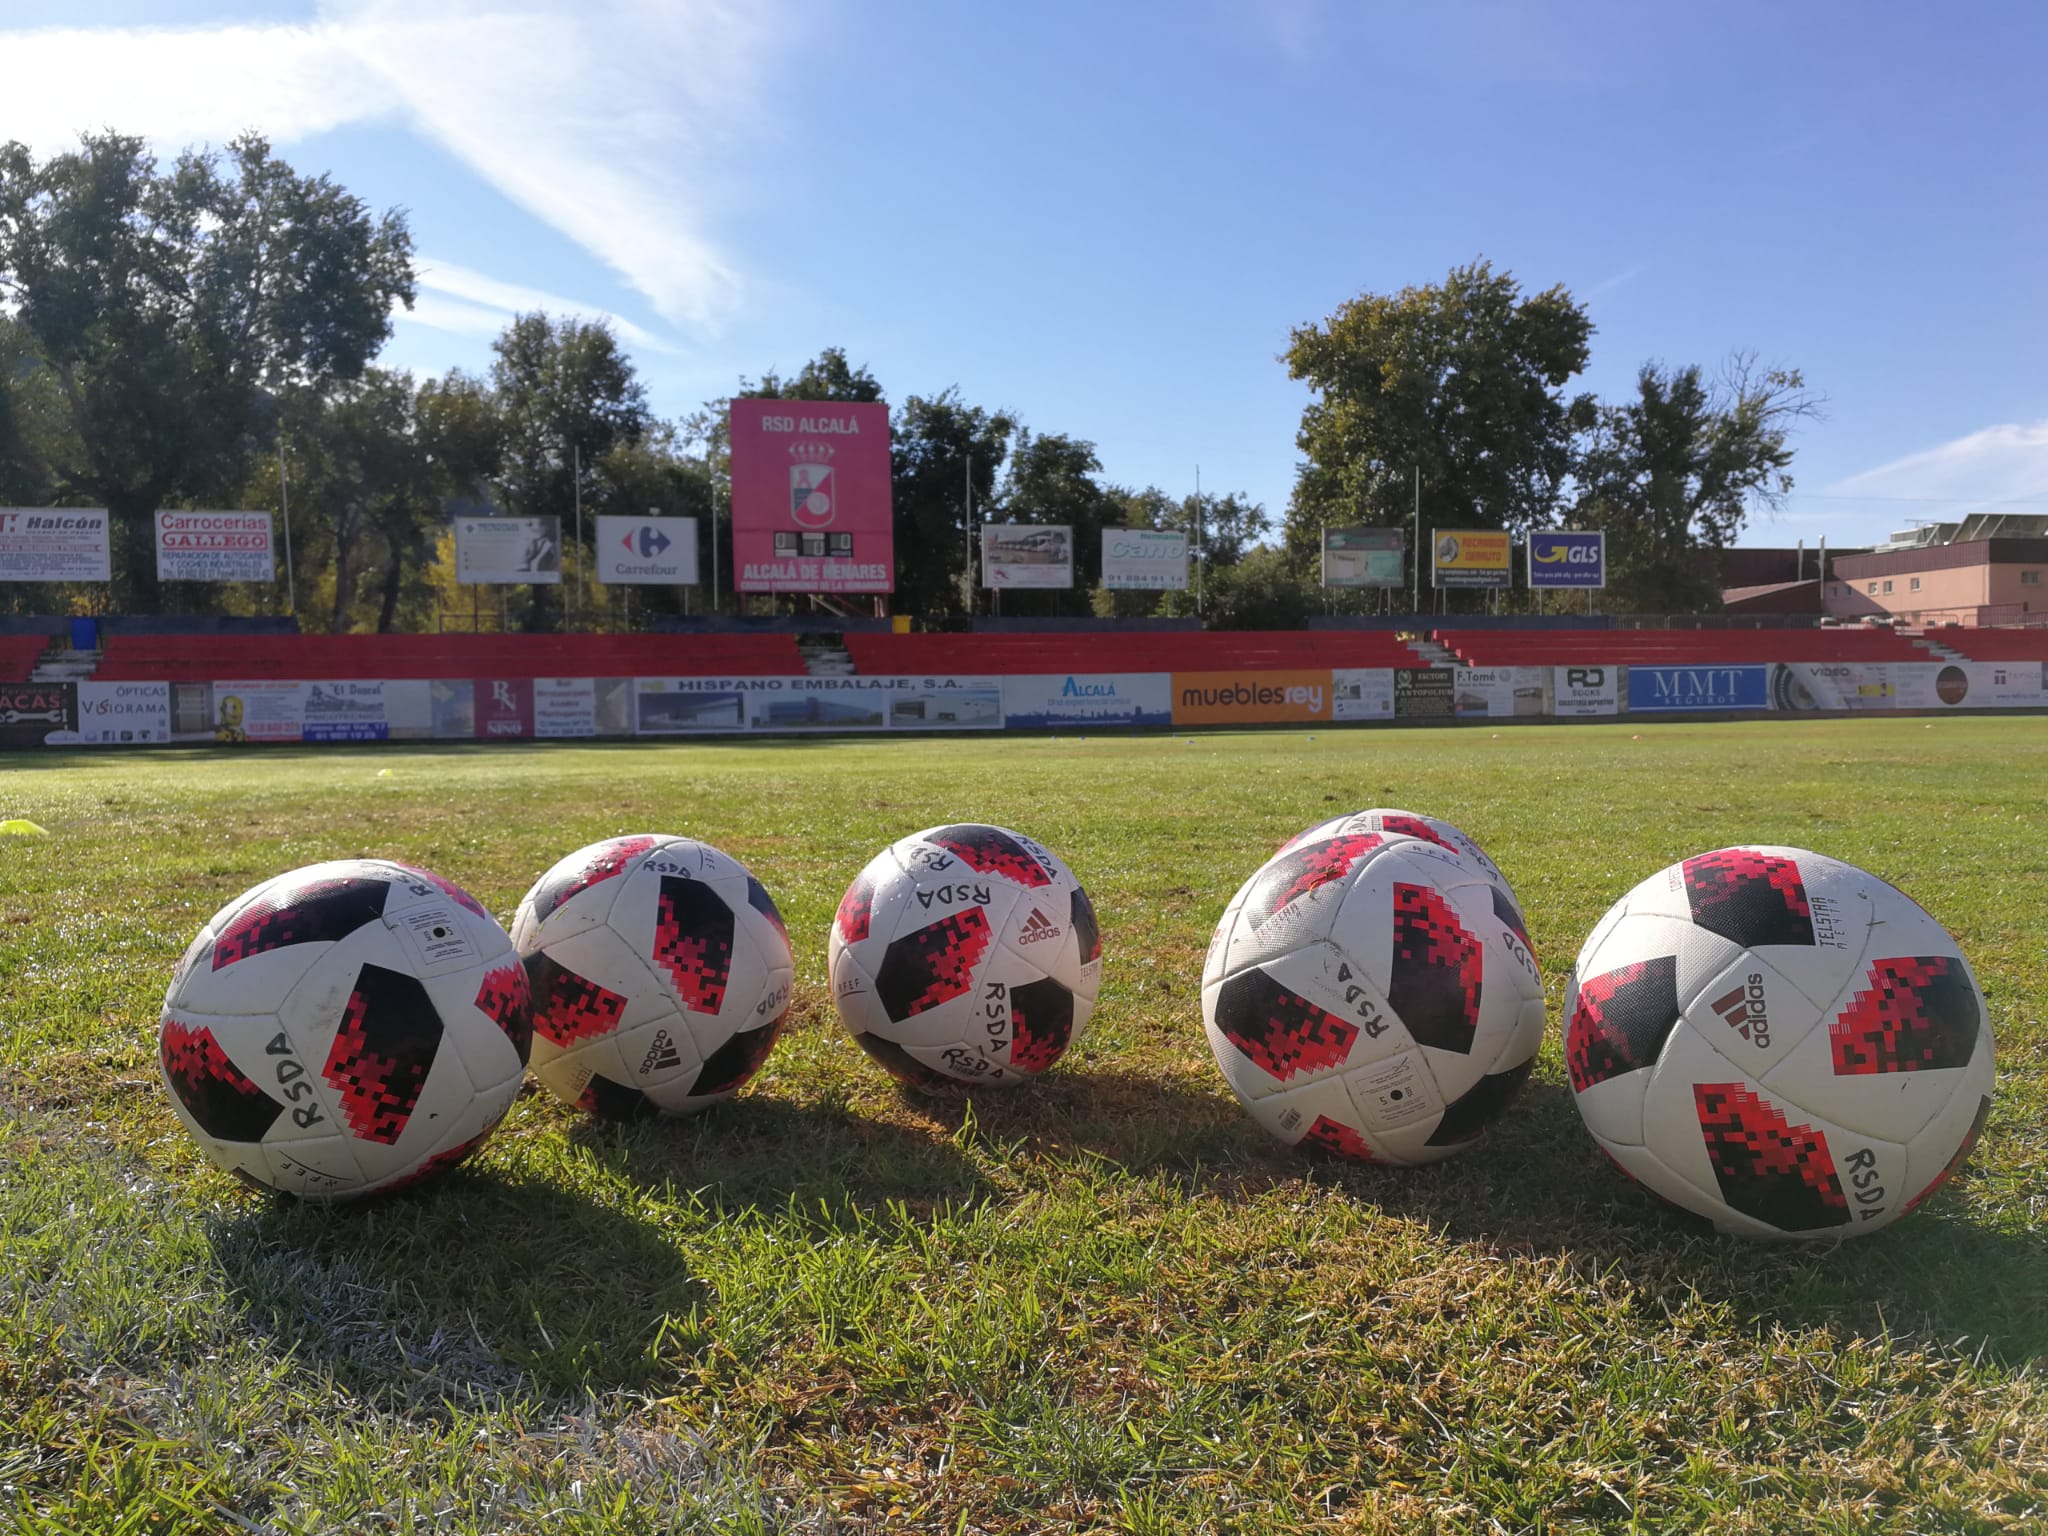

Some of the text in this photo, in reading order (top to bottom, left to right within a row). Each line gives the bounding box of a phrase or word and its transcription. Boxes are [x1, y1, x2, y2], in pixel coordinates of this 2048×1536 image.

[762, 415, 860, 435] RSD ALCALÁ
[27, 516, 102, 529] Halcón
[161, 513, 266, 529] Carrocerías
[162, 534, 265, 547] GALLEGO
[1568, 545, 1599, 564] GLS
[616, 563, 678, 576] Carrefour
[743, 561, 797, 579] ALCALÁ
[800, 564, 819, 579] DE
[1456, 670, 1496, 681] F.Tomé
[1810, 667, 1850, 677] VIDEO
[116, 686, 167, 697] ÓPTICAS
[678, 679, 963, 691] HISPANO EMBALAJE, S.A.
[1062, 676, 1116, 697] ALCALÁ
[1652, 670, 1743, 697] MMT
[643, 860, 692, 879] RSDA
[917, 884, 993, 909] RSDA
[1019, 926, 1062, 947] adidas
[1338, 961, 1391, 1039] RSDA
[985, 981, 1010, 1053] RSDA
[1747, 972, 1771, 1049] adidas
[639, 1029, 668, 1075] adidas
[941, 1048, 1004, 1078] RSDA
[265, 1031, 325, 1127] RSDA
[1845, 1147, 1887, 1224] RSDA
